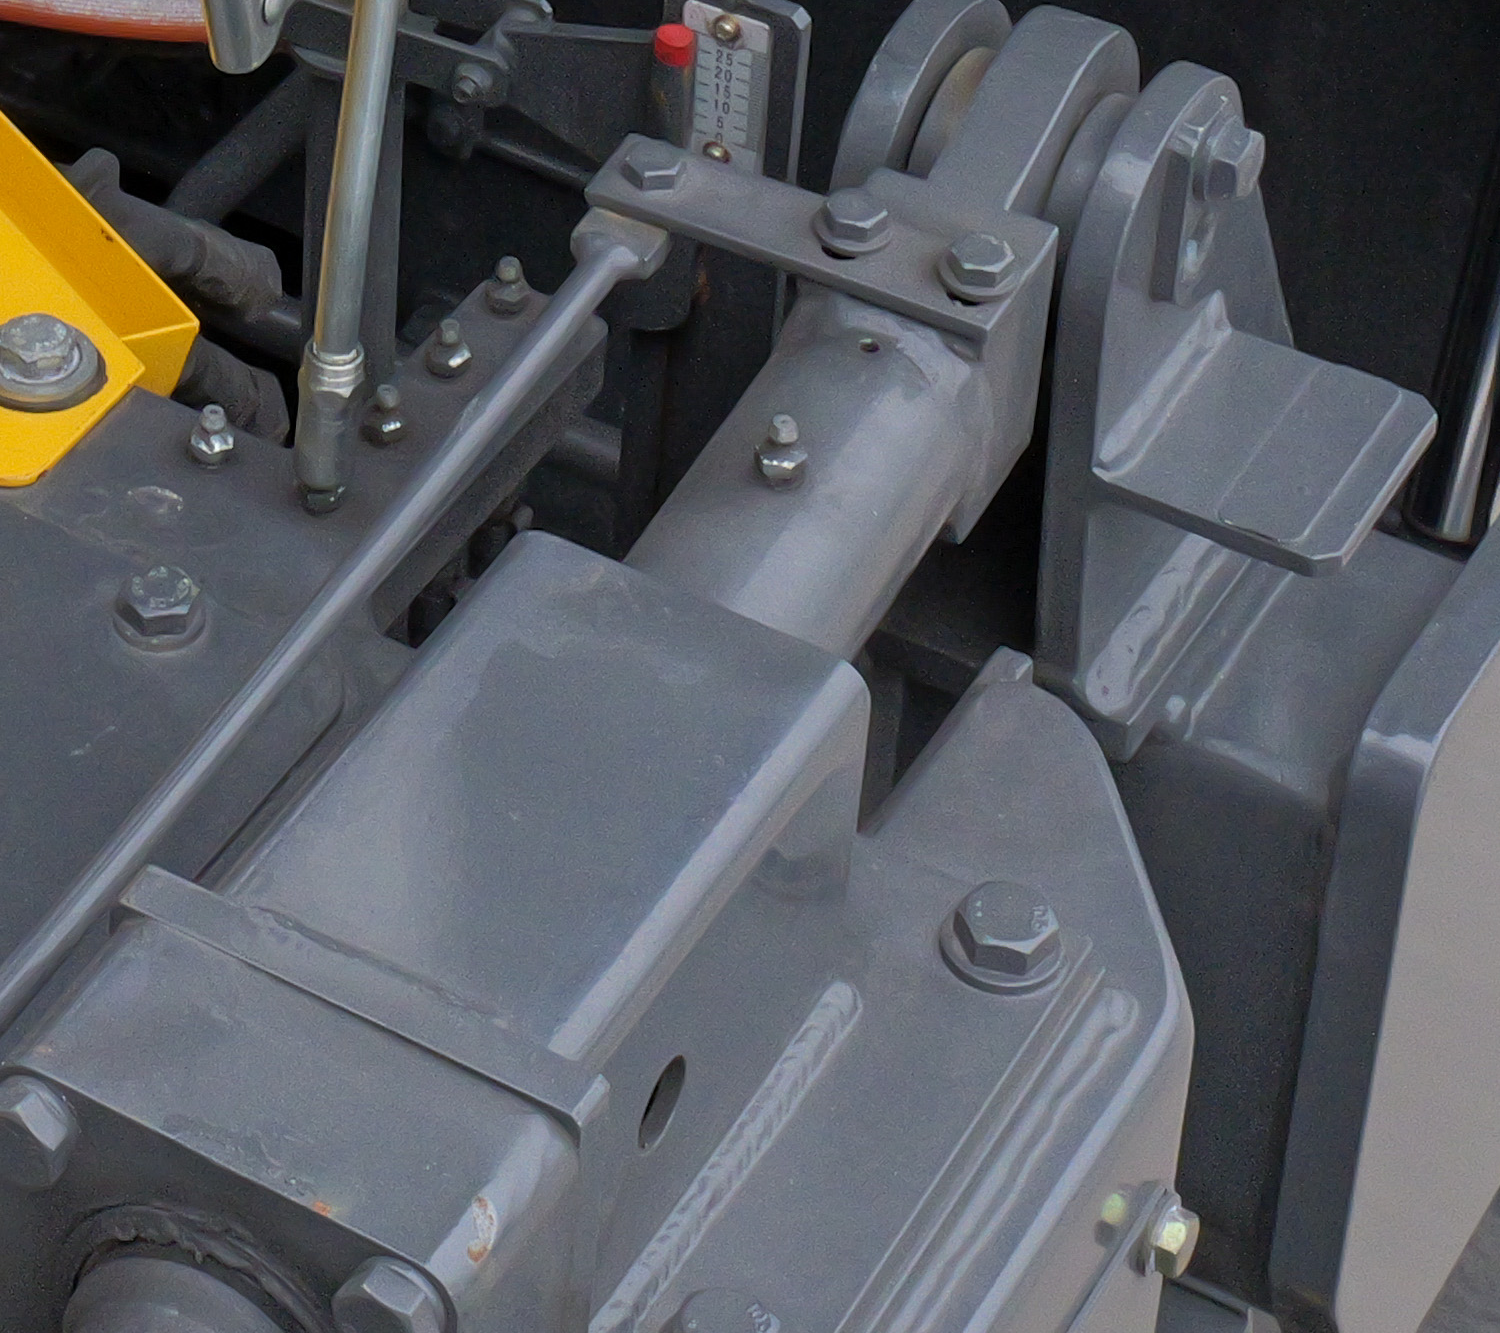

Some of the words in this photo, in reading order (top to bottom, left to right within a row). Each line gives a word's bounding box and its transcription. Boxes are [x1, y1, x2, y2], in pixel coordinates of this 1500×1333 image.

[716, 49, 733, 66] 25
[714, 66, 732, 83] 20
[715, 83, 731, 99] 15
[714, 99, 730, 115] 10
